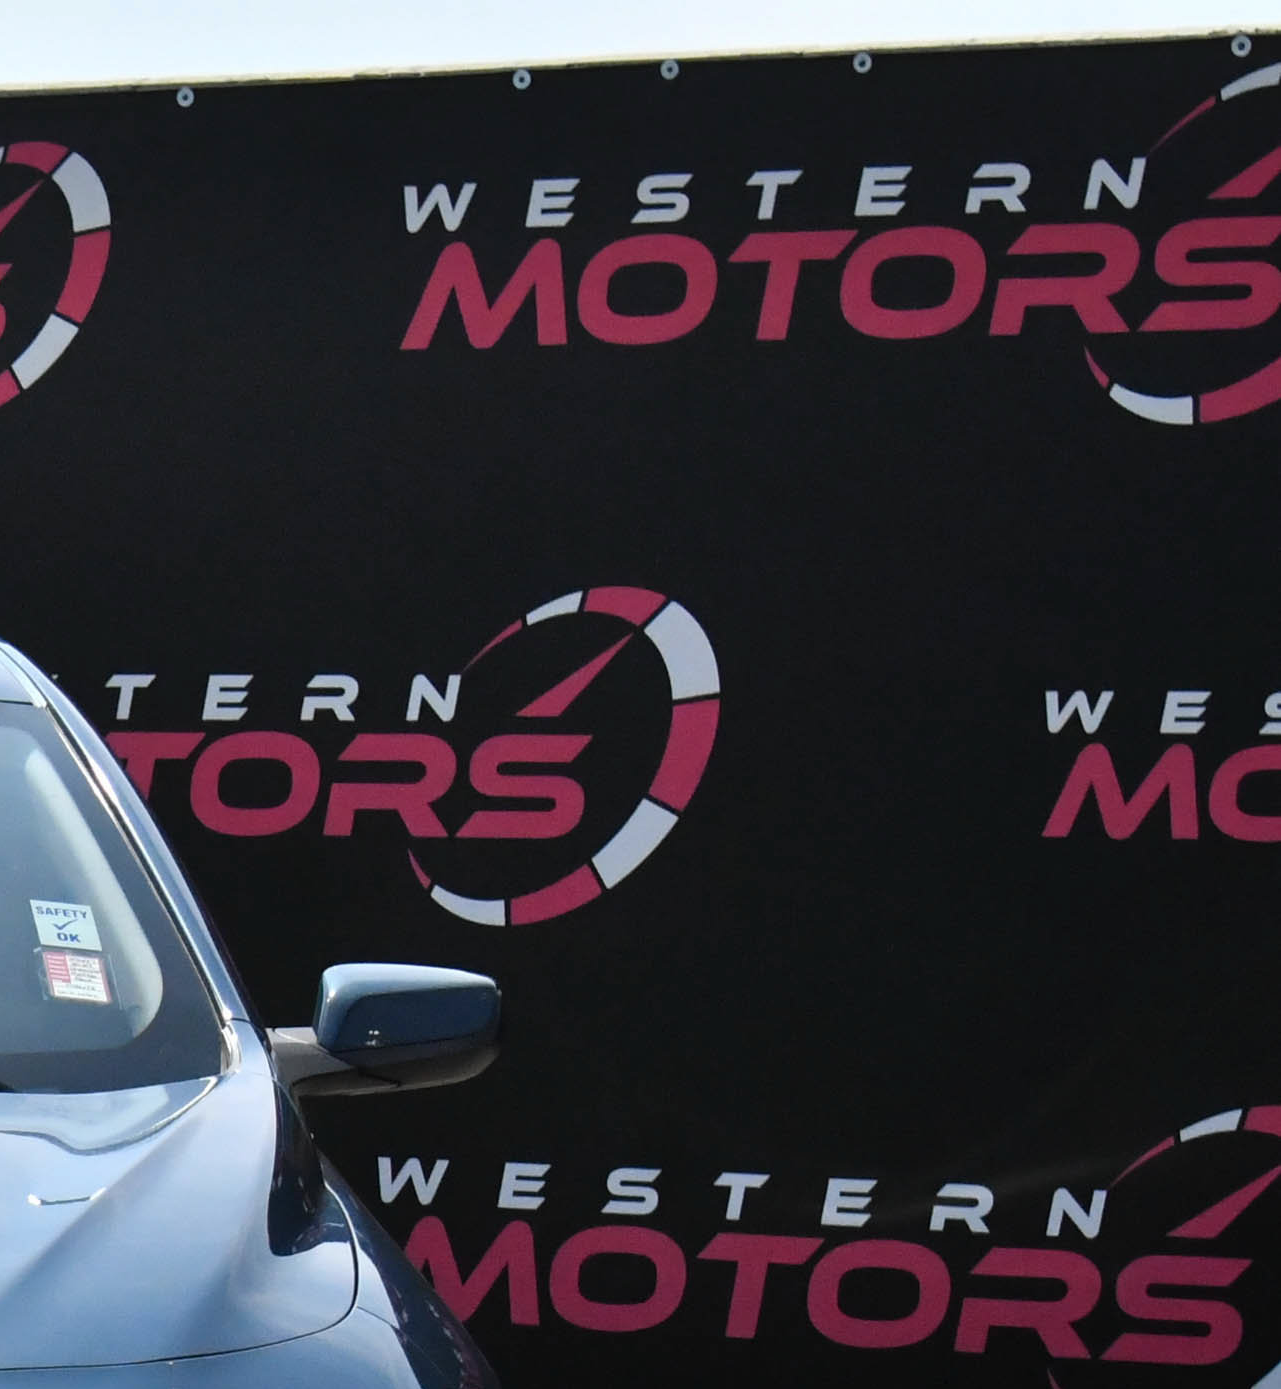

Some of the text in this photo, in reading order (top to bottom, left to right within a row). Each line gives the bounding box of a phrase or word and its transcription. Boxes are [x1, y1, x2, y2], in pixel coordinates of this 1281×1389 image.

[403, 157, 1147, 234] WESTERN
[399, 214, 1281, 351] MOTORS
[104, 673, 462, 722] TERN
[106, 730, 594, 839] TORS
[36, 906, 87, 919] SAFETY
[56, 932, 81, 943] OK
[376, 1156, 1108, 1239] WESTERN
[400, 1214, 1253, 1366] MOTORS
